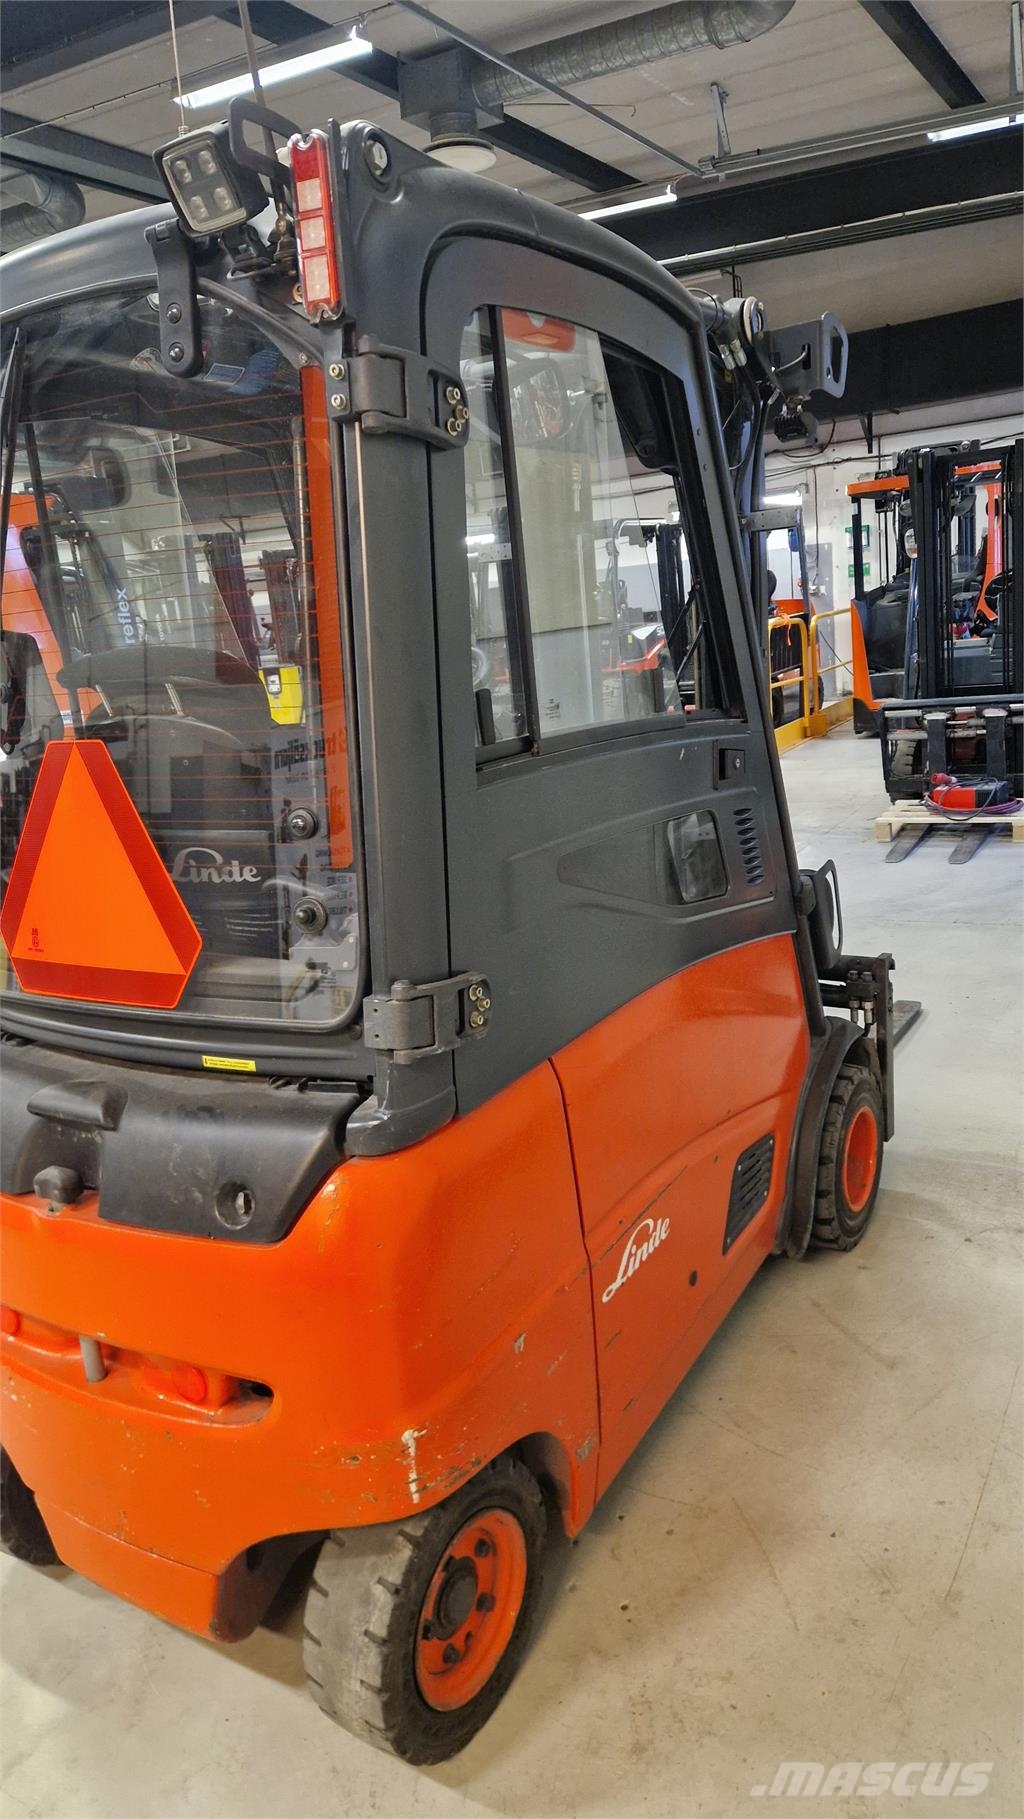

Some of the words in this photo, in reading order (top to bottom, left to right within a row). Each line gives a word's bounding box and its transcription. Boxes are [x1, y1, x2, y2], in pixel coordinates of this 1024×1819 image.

[116, 588, 135, 644] reflex
[170, 846, 262, 884] Linde
[602, 1218, 671, 1303] Linde
